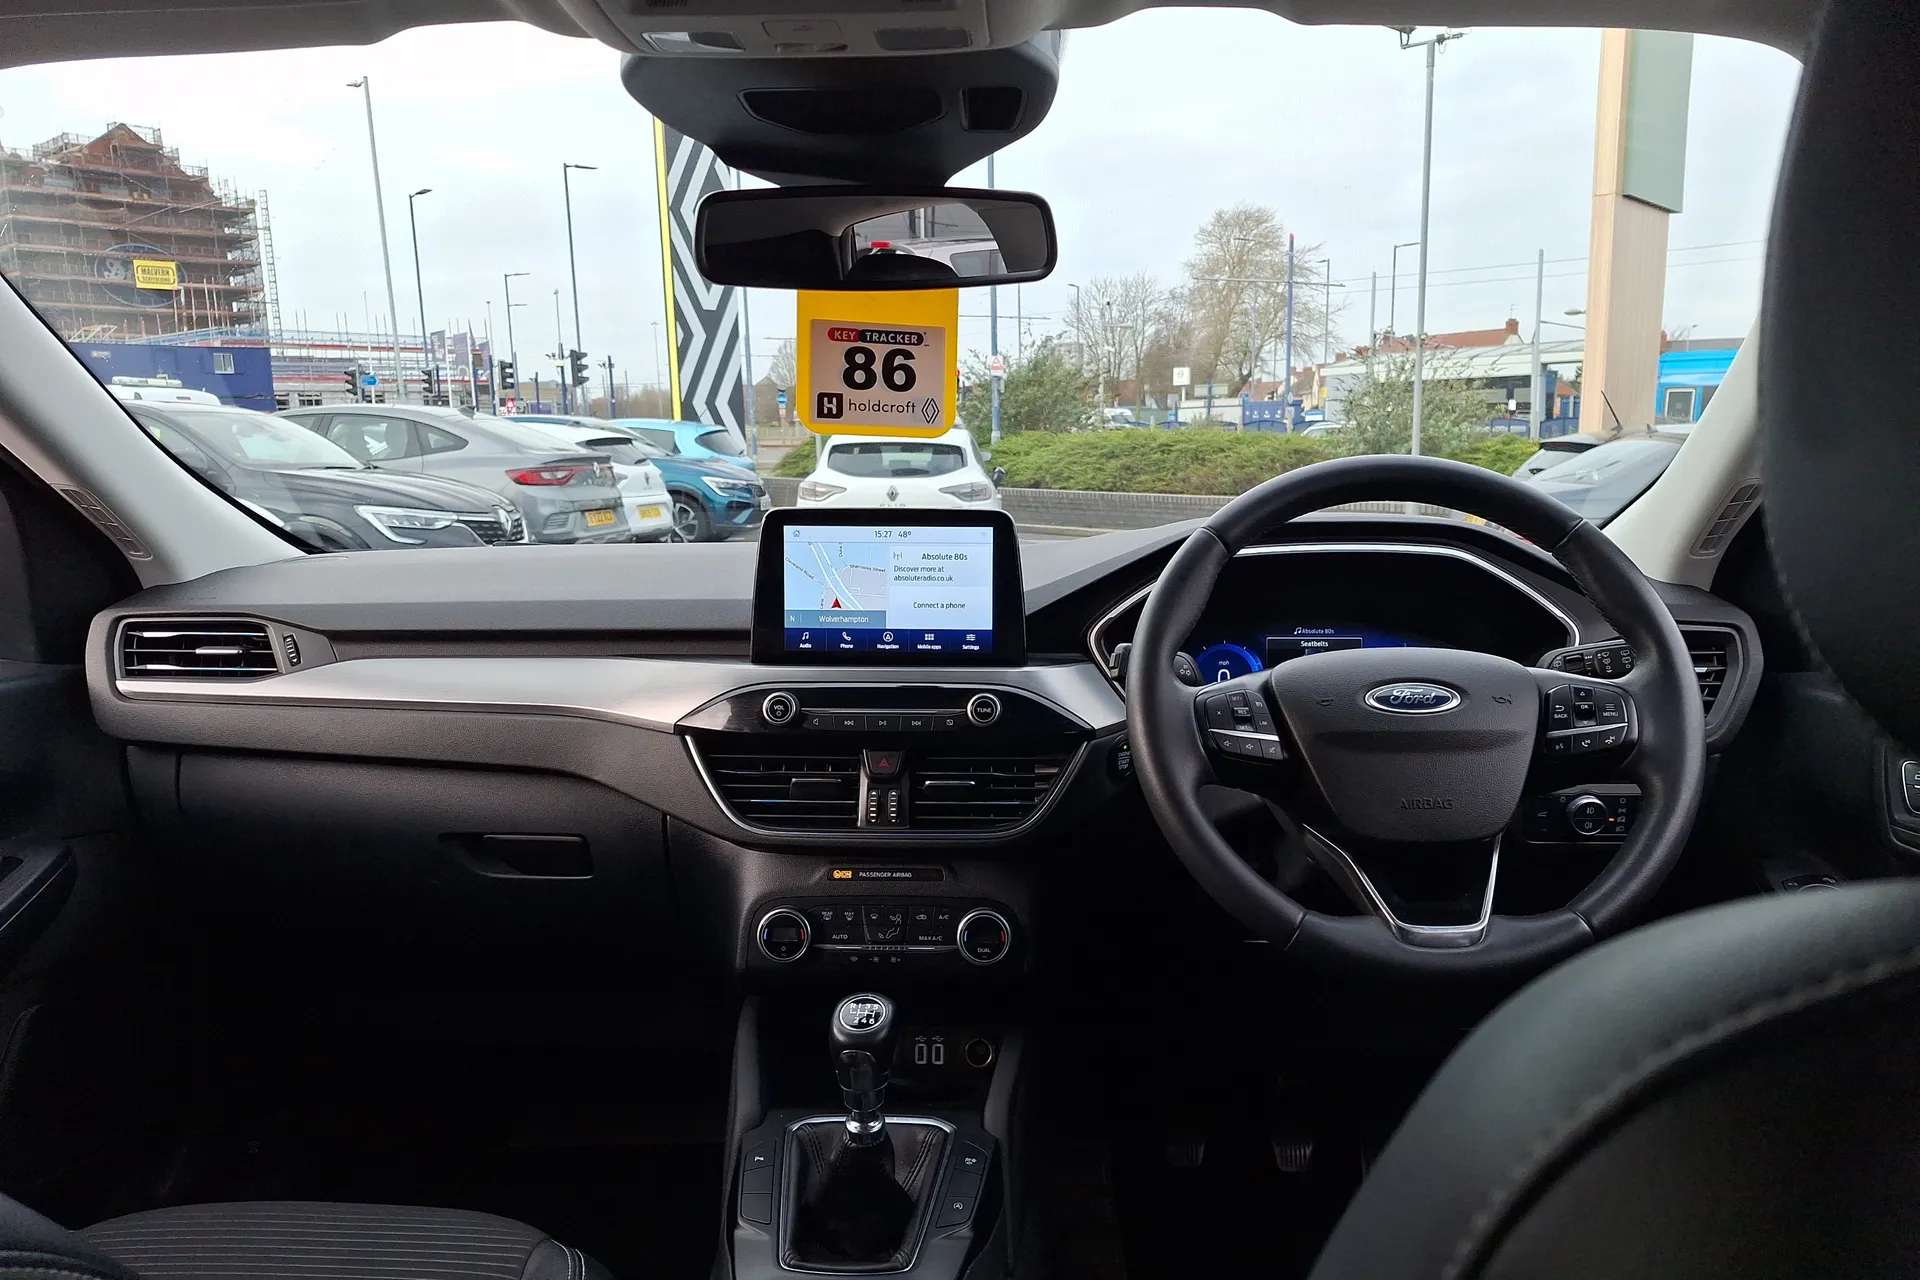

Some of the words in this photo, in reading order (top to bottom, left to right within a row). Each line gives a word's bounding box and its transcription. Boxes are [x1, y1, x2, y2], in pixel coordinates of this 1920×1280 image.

[834, 330, 856, 340] KEY
[865, 332, 918, 344] TRACKER
[842, 346, 917, 393] 86
[823, 397, 837, 415] H
[848, 398, 916, 414] holdcroft
[874, 530, 893, 538] 15:27
[921, 552, 953, 561] Absolute
[953, 553, 968, 561] 80s
[893, 565, 919, 573] Discover
[937, 565, 945, 573] at
[893, 574, 953, 582] absoluteradio.co.uk
[945, 602, 966, 611] phone
[819, 615, 869, 625] Wolverhampton
[1300, 640, 1329, 648] Seatbelts
[1389, 688, 1437, 705] Ford
[1400, 799, 1453, 810] AIRBAG
